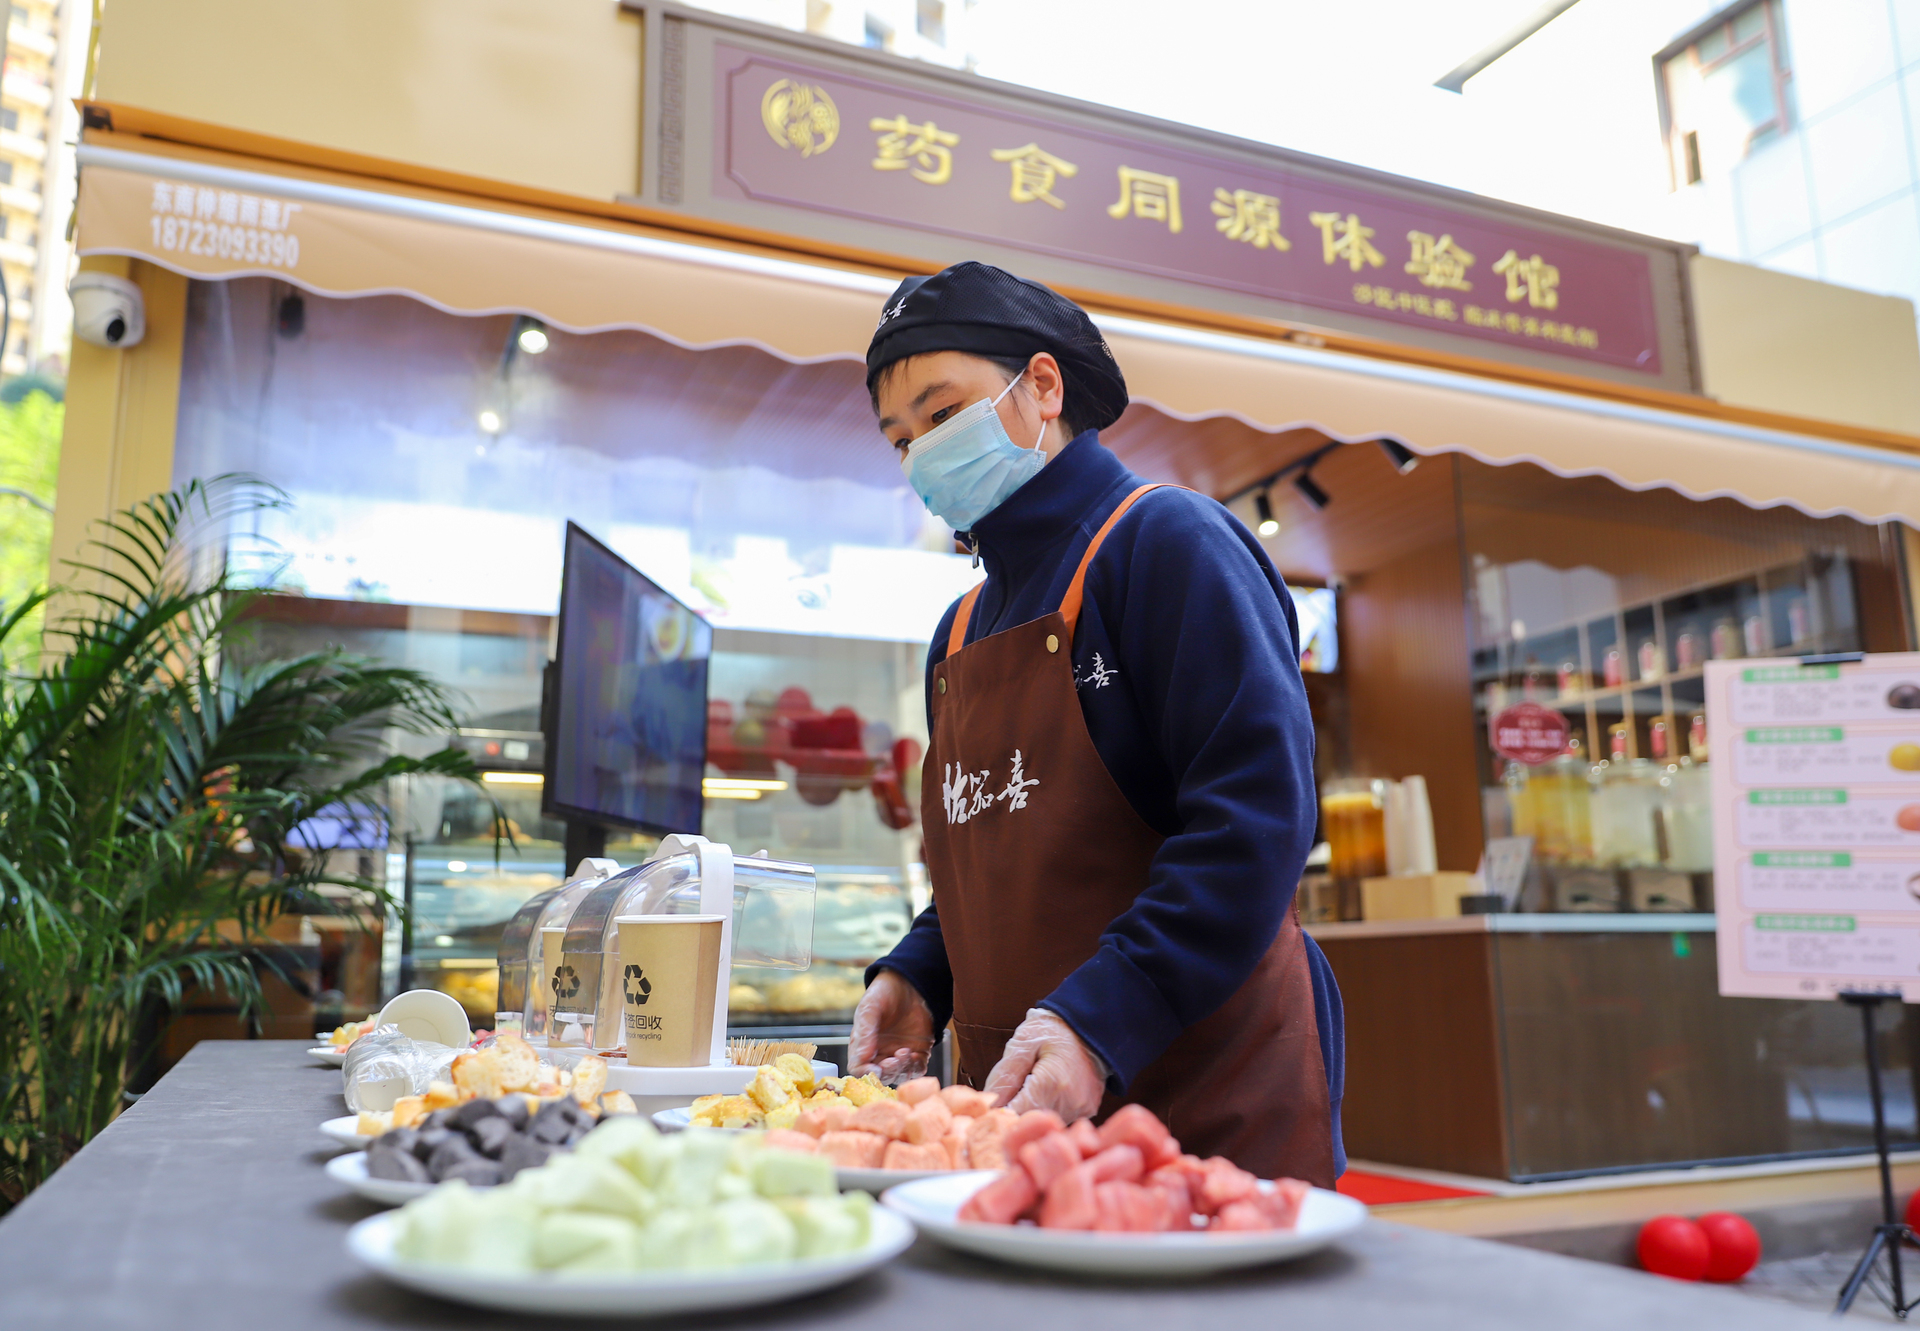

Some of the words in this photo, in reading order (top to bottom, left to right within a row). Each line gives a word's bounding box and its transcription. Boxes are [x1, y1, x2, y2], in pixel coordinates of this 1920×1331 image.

[869, 115, 1560, 311] 药食同源体验馆
[151, 214, 300, 269] 18723093390
[637, 1033, 662, 1041] recycling
